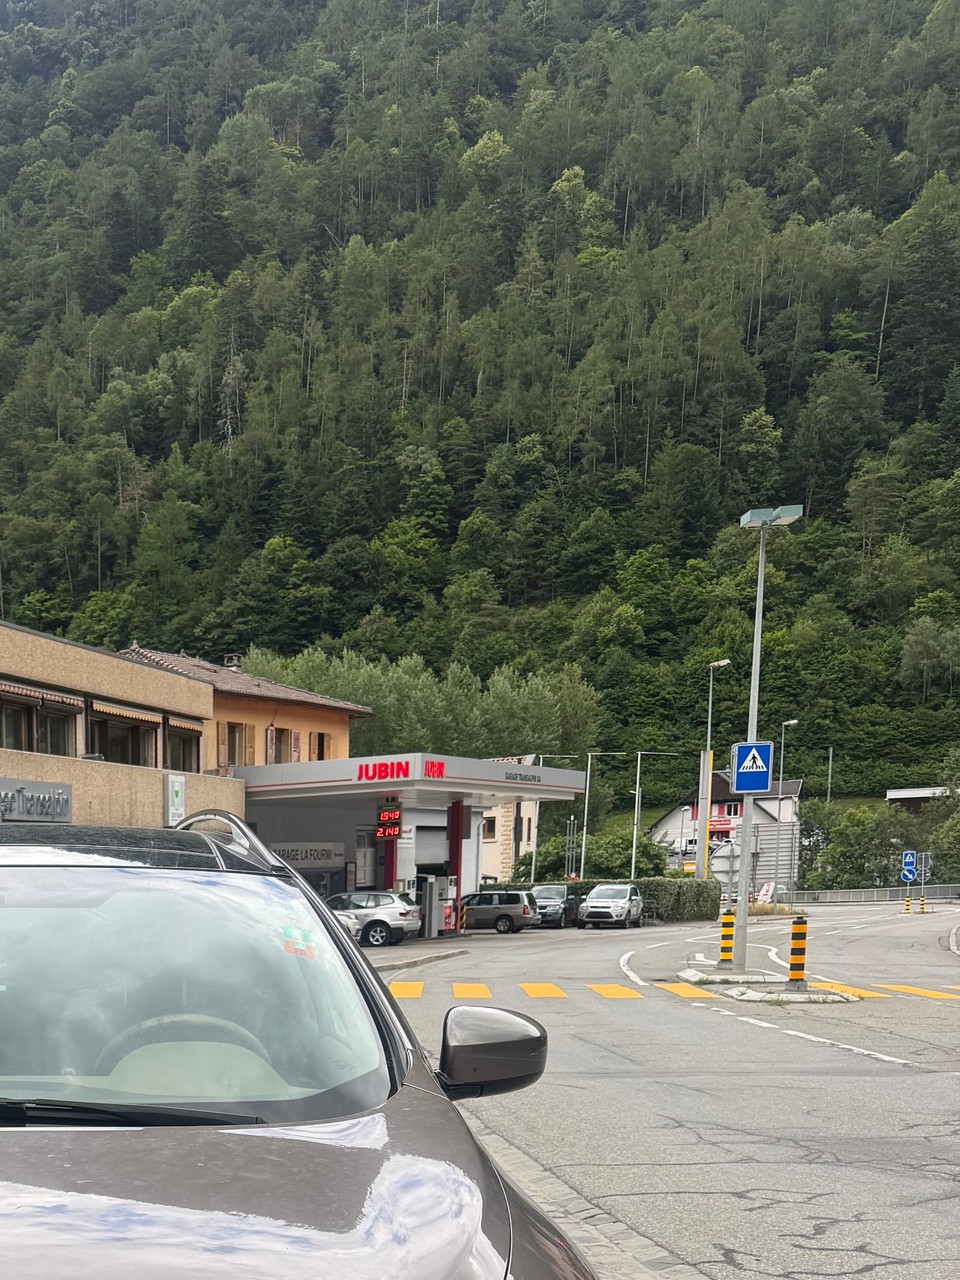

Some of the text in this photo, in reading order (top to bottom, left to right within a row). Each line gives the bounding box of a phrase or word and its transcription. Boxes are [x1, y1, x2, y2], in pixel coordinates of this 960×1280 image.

[357, 760, 409, 781] JUBIN
[424, 760, 445, 779] JUBIN
[16, 786, 70, 820] Transalpin
[300, 848, 308, 861] LA
[309, 848, 332, 860] FOURMI
